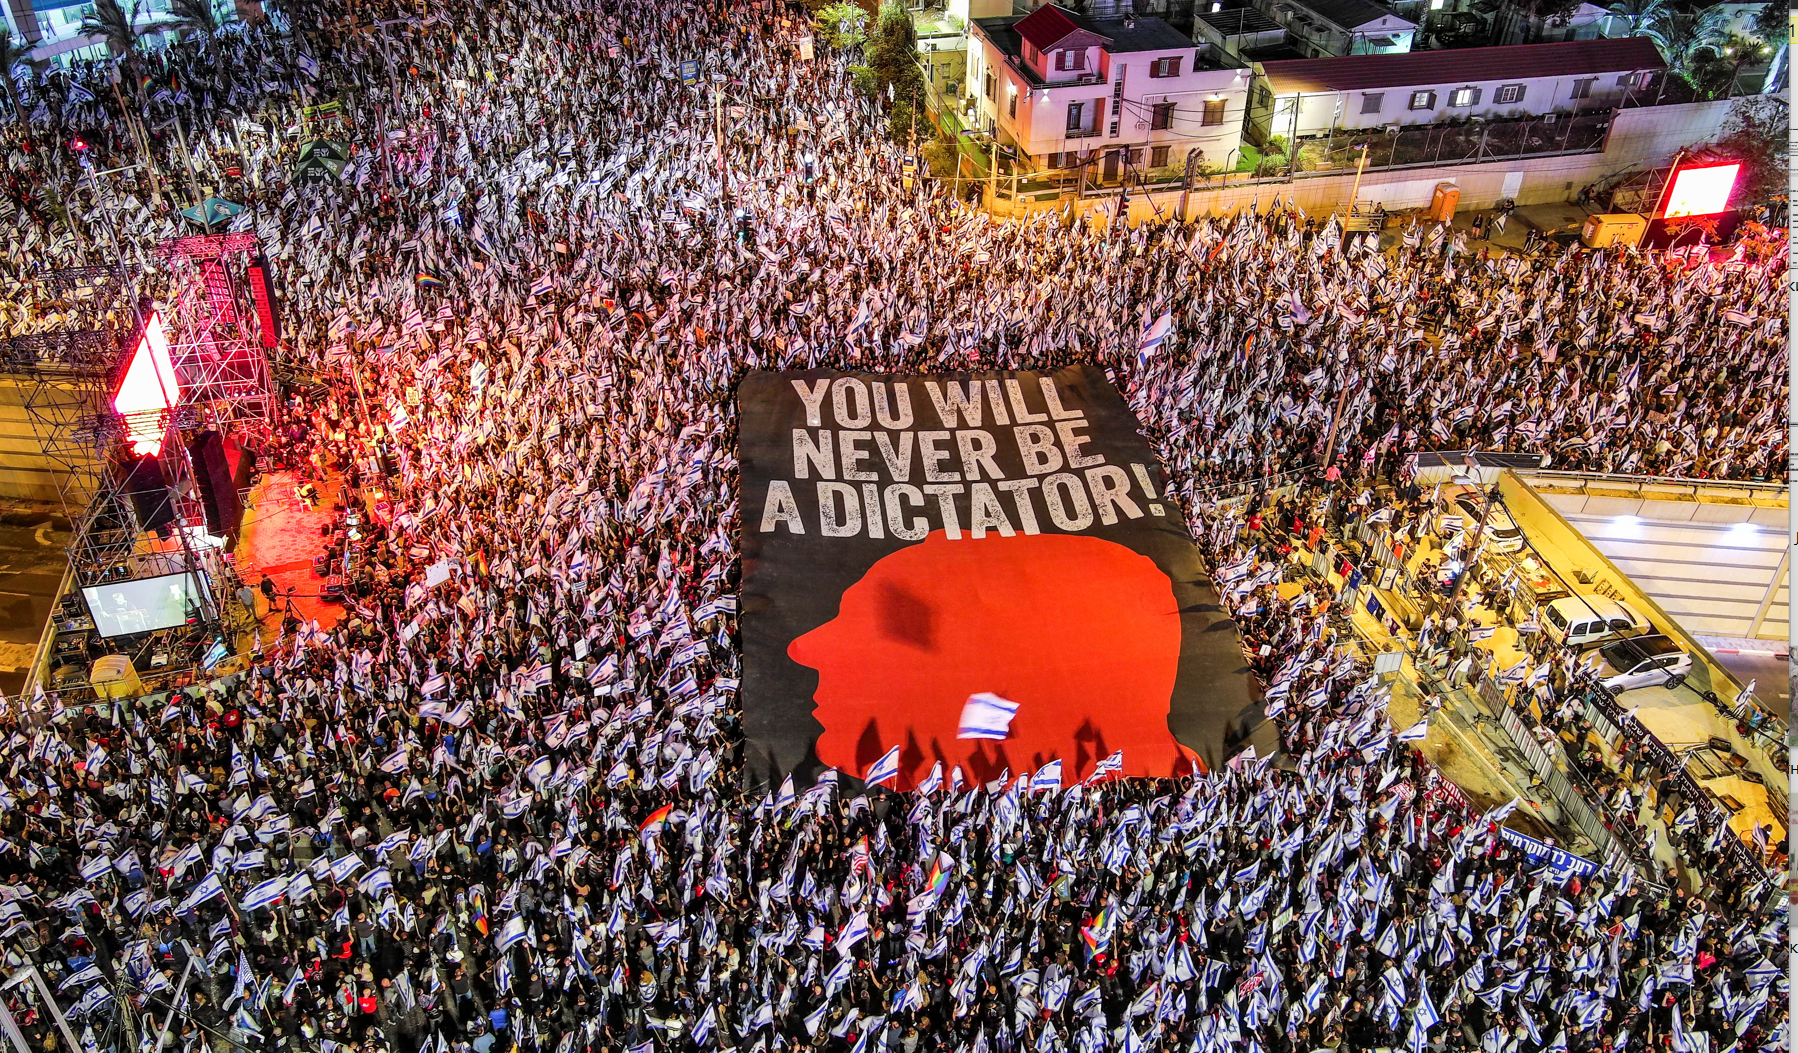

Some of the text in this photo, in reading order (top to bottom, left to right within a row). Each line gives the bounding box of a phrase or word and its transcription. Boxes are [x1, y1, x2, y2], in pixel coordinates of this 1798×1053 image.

[791, 376, 1084, 430] YOU WILL
[792, 419, 1105, 482] NEVER BE
[759, 462, 1167, 541] A DICTATOR!
